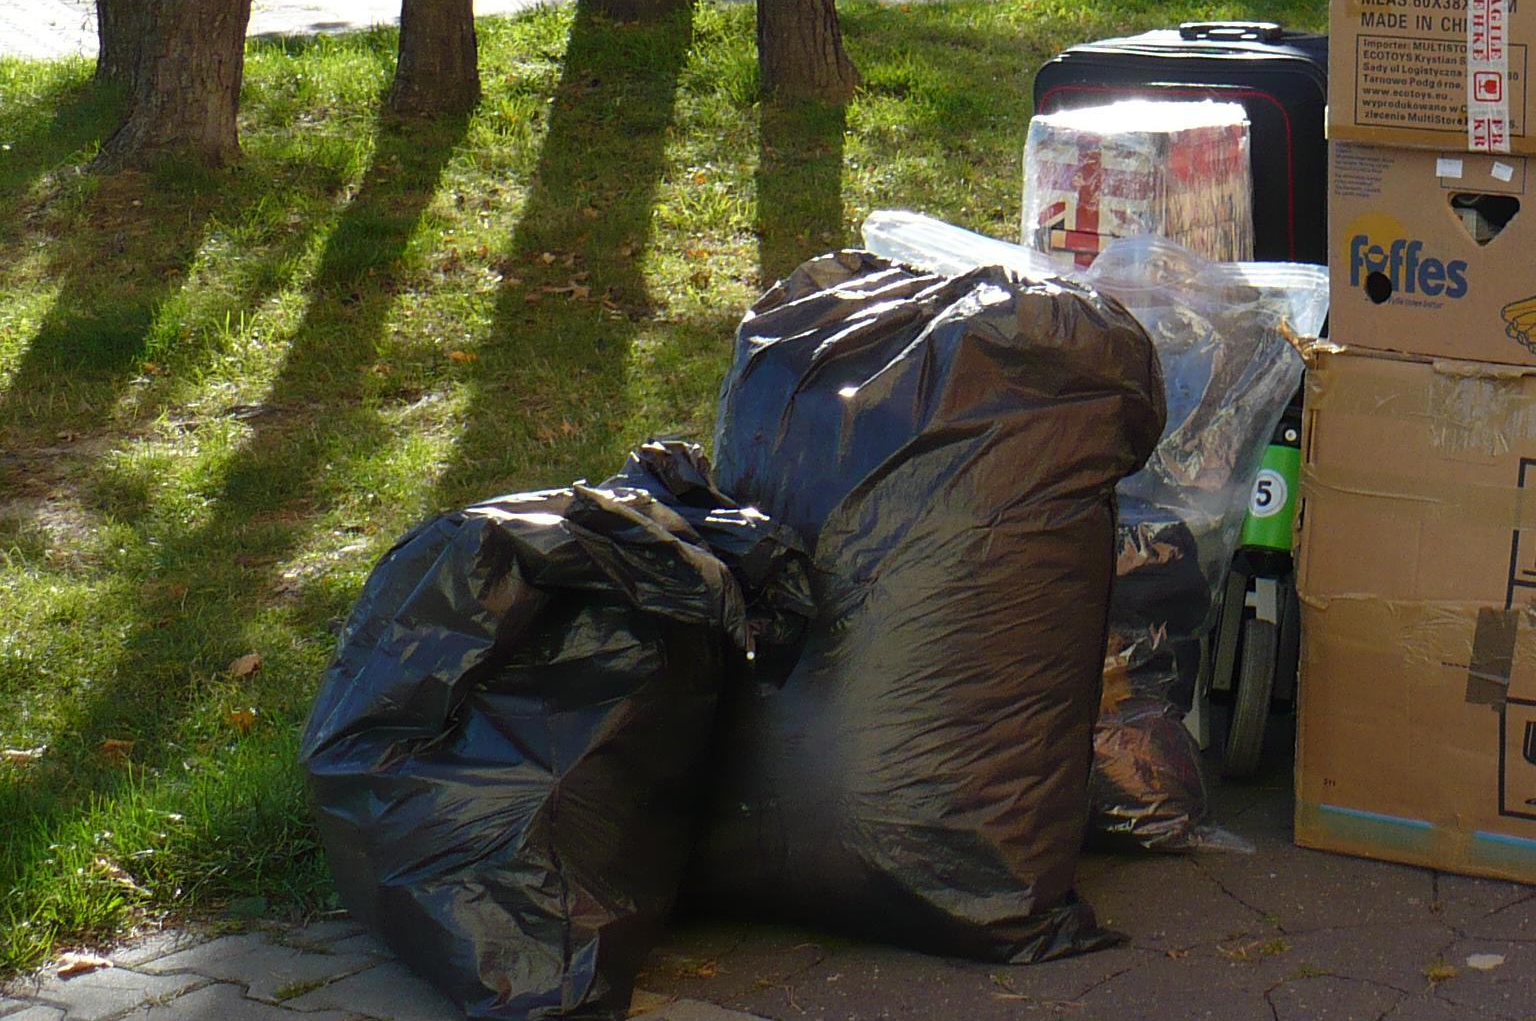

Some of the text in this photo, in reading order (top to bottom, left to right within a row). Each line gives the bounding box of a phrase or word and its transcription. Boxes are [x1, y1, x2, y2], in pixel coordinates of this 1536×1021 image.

[1361, 12, 1467, 34] MADE IN CHI
[1363, 50, 1412, 62] ECOTOYS
[1414, 54, 1457, 66] Krystian
[1363, 63, 1388, 74] Sady
[1402, 66, 1462, 78] Logistyczna
[1363, 74, 1407, 85] Tarnowo
[1362, 99, 1447, 112] wyprodukowano
[1364, 109, 1406, 121] zlecenie
[1256, 480, 1272, 507] 5
